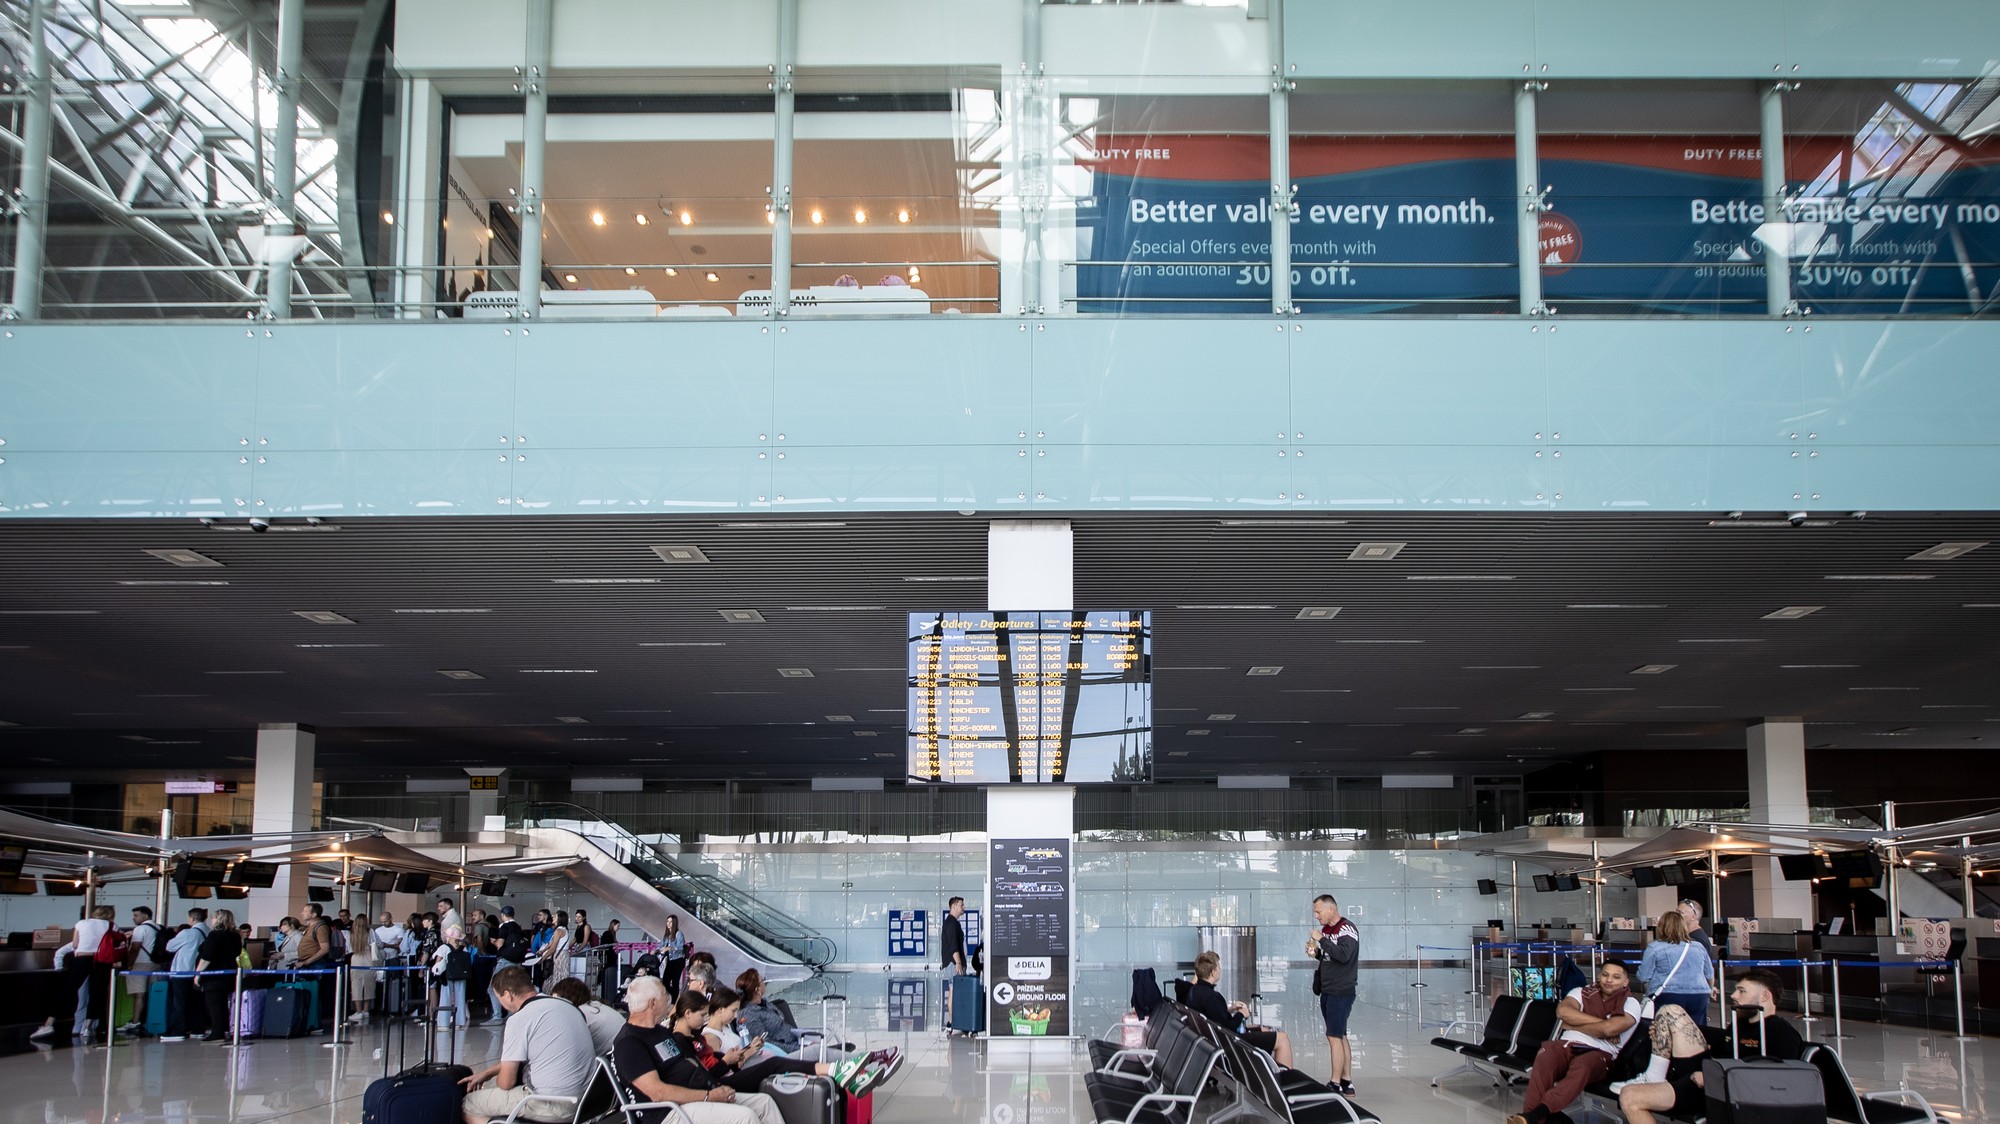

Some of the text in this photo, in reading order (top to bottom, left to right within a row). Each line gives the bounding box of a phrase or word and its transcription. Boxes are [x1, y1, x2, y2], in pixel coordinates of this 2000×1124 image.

[1134, 148, 1171, 160] FREE
[1684, 148, 1724, 161] DUTY
[1131, 197, 1496, 230] Better vale every month.
[1691, 199, 1765, 224] Bette
[1869, 203, 1950, 230] every
[1132, 240, 1186, 257] Special
[1190, 239, 1236, 254] Offers
[1290, 240, 1337, 255] month
[1340, 240, 1376, 254] with
[1550, 233, 1574, 250] FREE
[1904, 240, 1937, 254] with
[1133, 265, 1151, 276] an
[1310, 260, 1356, 286] off.
[1871, 260, 1918, 286] off.
[940, 620, 973, 630] Odlety
[980, 620, 1034, 629] Departures
[1016, 984, 1044, 992] PRÍZEMIE
